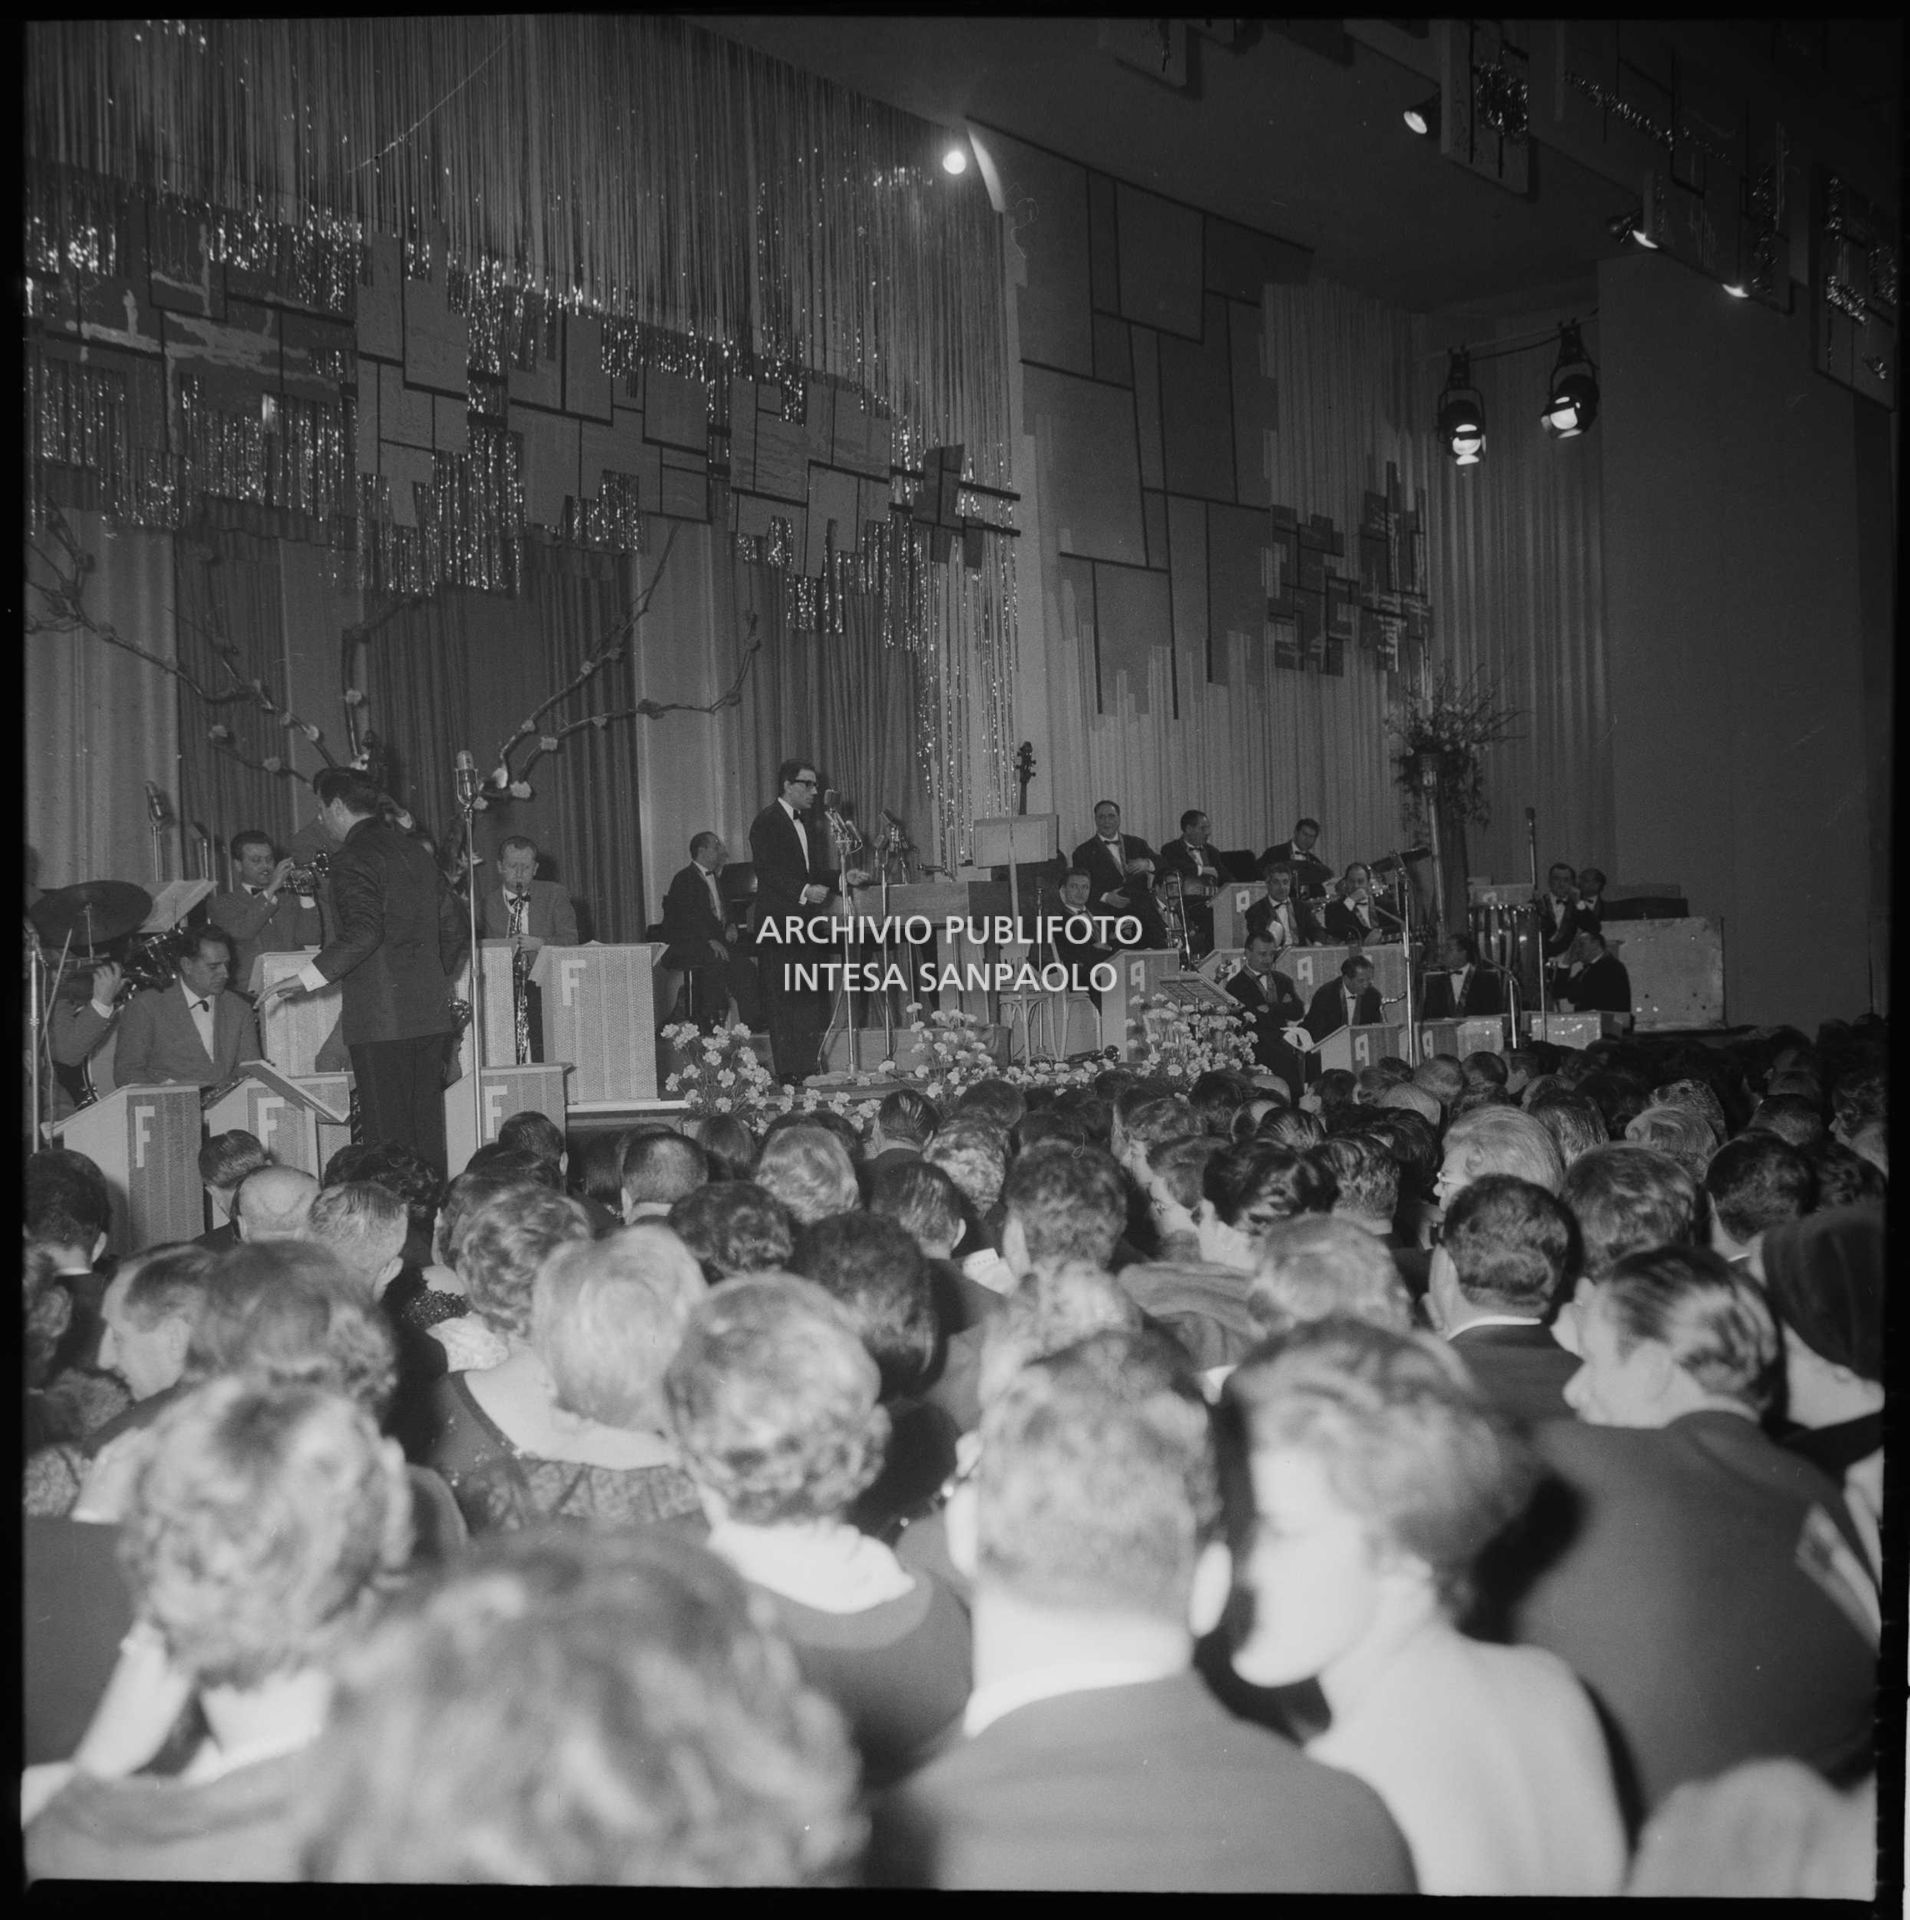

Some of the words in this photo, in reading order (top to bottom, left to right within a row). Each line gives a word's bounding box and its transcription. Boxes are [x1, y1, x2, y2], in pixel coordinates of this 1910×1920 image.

[561, 959, 586, 1006] F
[135, 1105, 155, 1168] F
[257, 1096, 285, 1152] F
[484, 1085, 508, 1140] F
